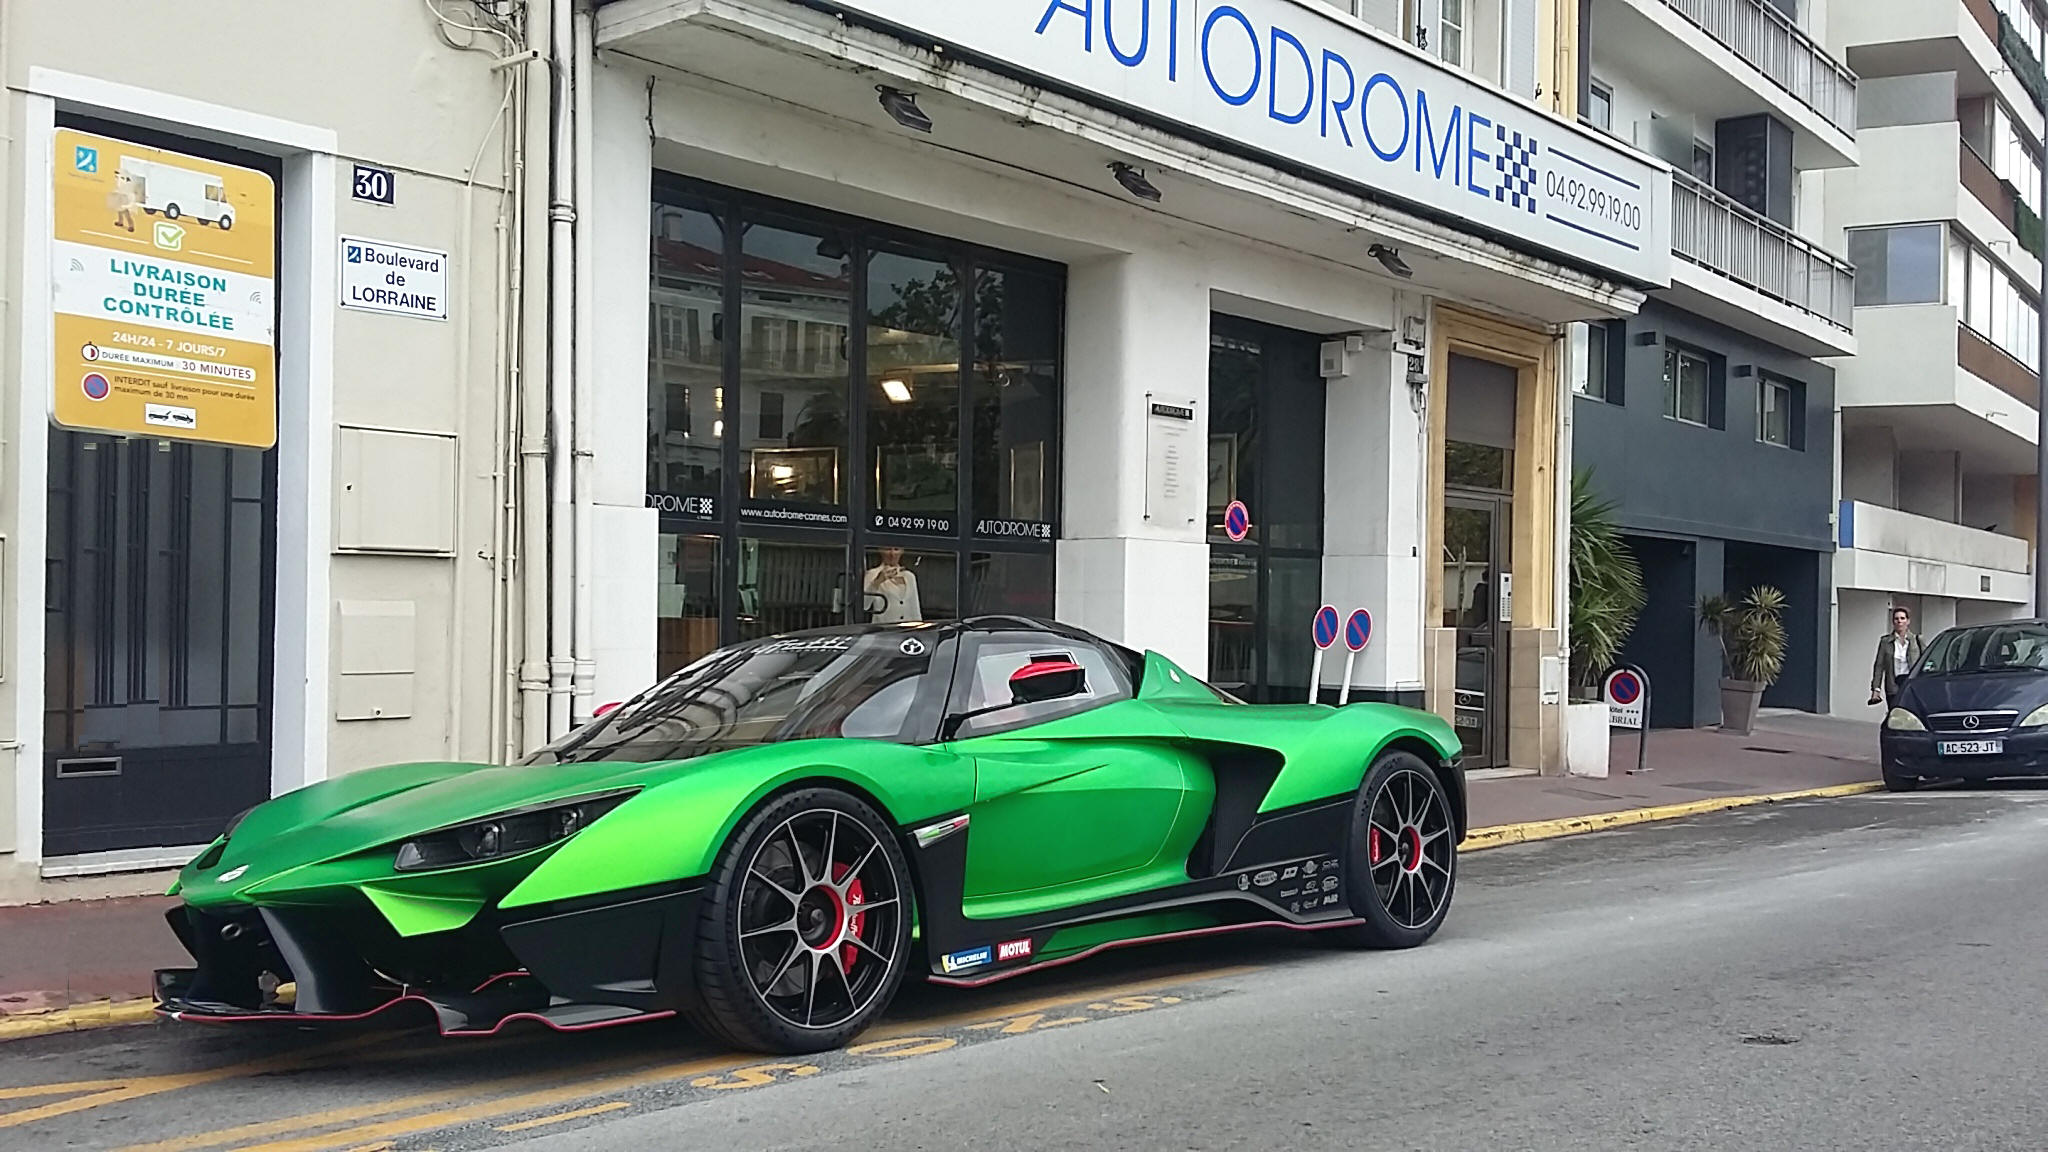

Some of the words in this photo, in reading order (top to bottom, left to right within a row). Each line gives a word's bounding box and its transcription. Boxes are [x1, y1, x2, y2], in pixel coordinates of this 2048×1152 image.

[1034, 0, 1491, 198] AUTODROME
[355, 168, 388, 200] 30
[1546, 169, 1641, 231] 04.92.99.19.00
[364, 247, 439, 273] Boulevard
[110, 258, 227, 292] LIVRAISON
[385, 271, 406, 287] de
[133, 282, 206, 307] DURÉE
[352, 286, 437, 311] LORRAINE
[103, 297, 234, 331] CONTRÔLÉE
[112, 331, 157, 348] 24H/24
[166, 339, 174, 349] 7
[176, 341, 226, 357] JOURS/7
[101, 350, 130, 362] DURÉE
[132, 355, 174, 367] MAXIMUM
[182, 360, 196, 371] 30
[200, 363, 252, 379] MINUTES
[114, 375, 151, 388] INTERDIT
[114, 386, 151, 396] maximum
[888, 516, 899, 528] 04
[901, 517, 912, 529] 92
[913, 518, 925, 529] 99
[927, 518, 937, 530] 19
[937, 520, 949, 531] 00
[975, 519, 1041, 538] AUTODROME
[1960, 742, 1980, 753] 523
[956, 951, 988, 965] MICHELIN
[999, 940, 1030, 958] MOTUL
